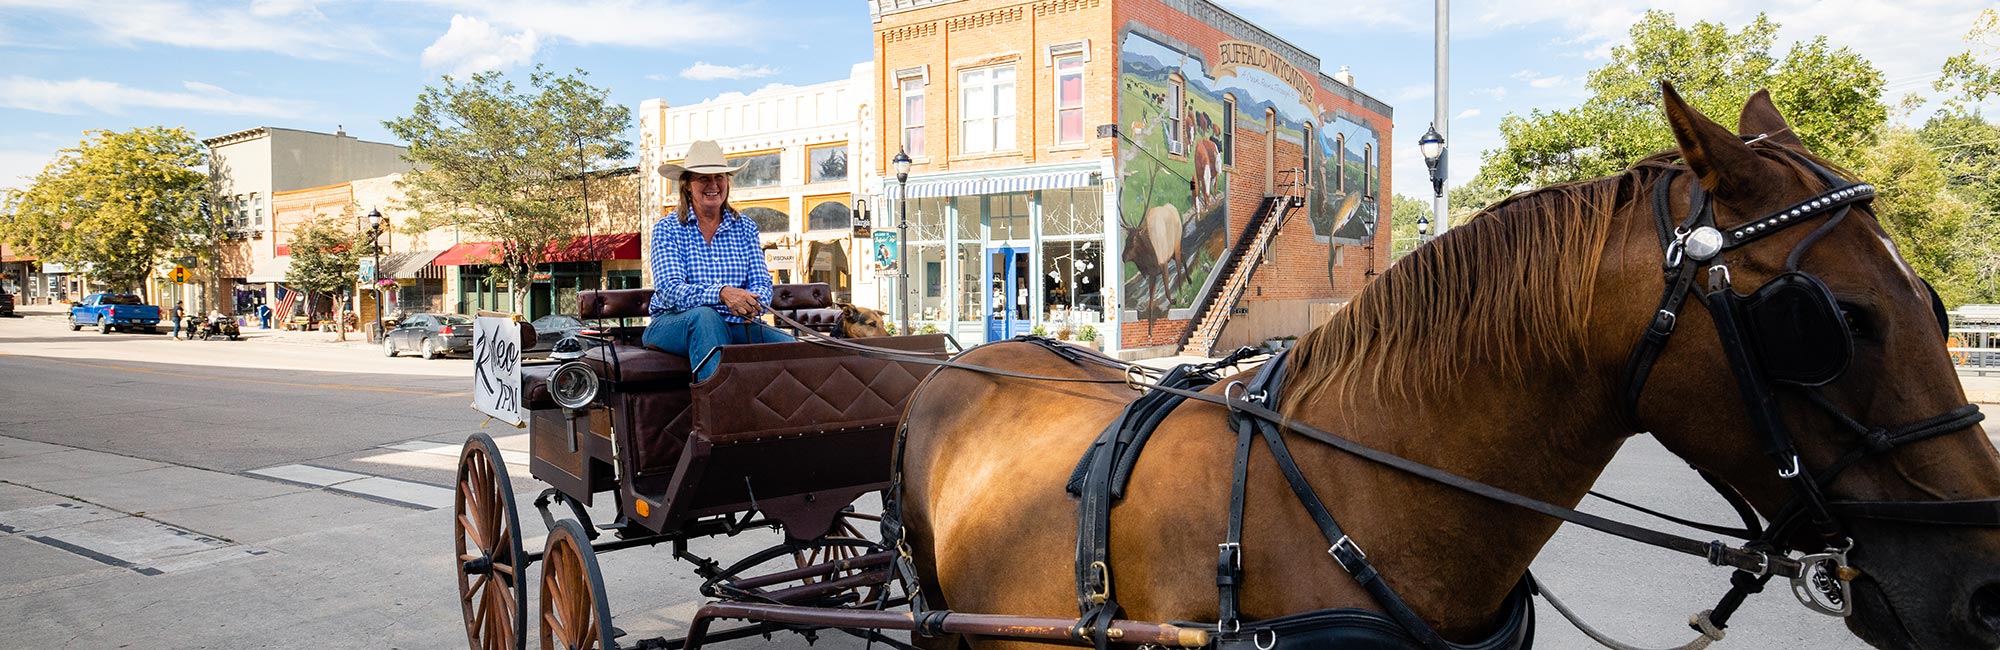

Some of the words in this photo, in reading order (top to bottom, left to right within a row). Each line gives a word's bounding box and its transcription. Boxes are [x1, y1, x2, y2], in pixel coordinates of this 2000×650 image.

[1220, 43, 1267, 69] BUFFALO
[1270, 53, 1313, 102] WYOMING
[475, 324, 519, 397] Rdeo
[495, 377, 518, 414] 7PM
